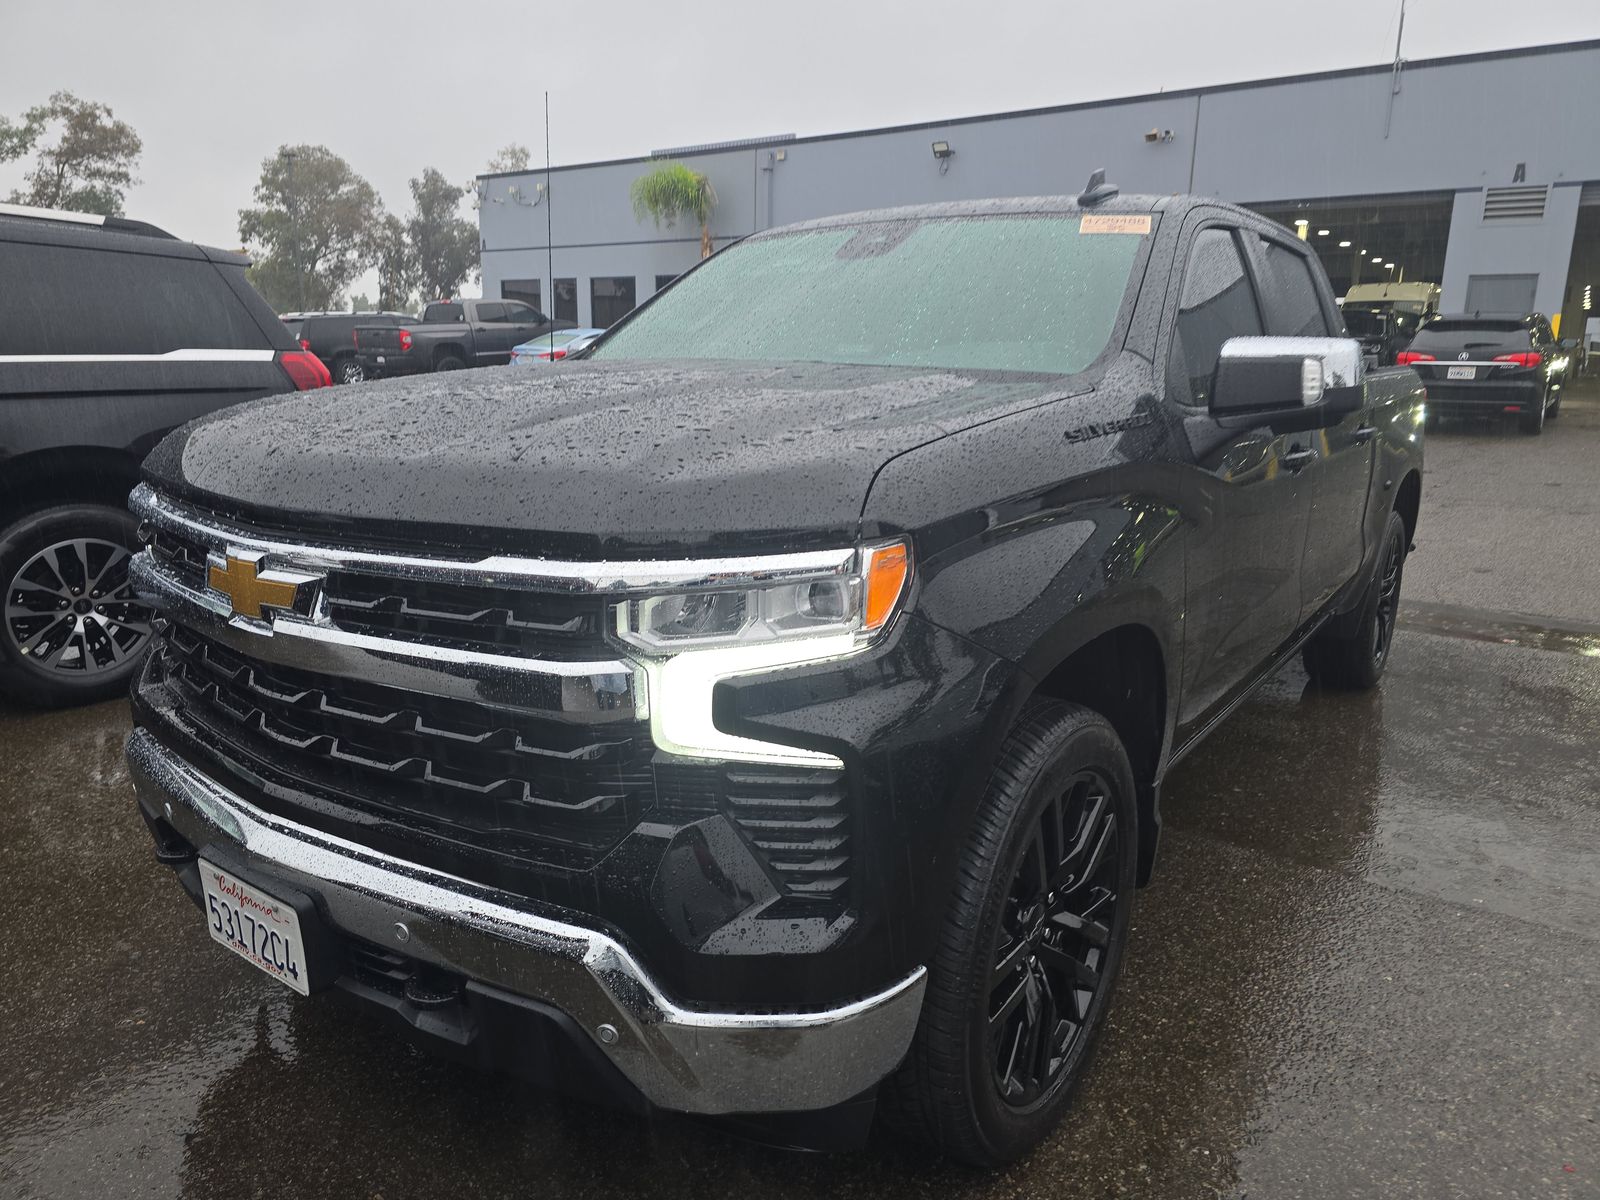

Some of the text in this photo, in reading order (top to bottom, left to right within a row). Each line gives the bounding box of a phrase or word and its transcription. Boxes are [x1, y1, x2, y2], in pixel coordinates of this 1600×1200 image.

[1512, 162, 1526, 183] A
[219, 875, 281, 923] California
[208, 893, 299, 981] 53172C4
